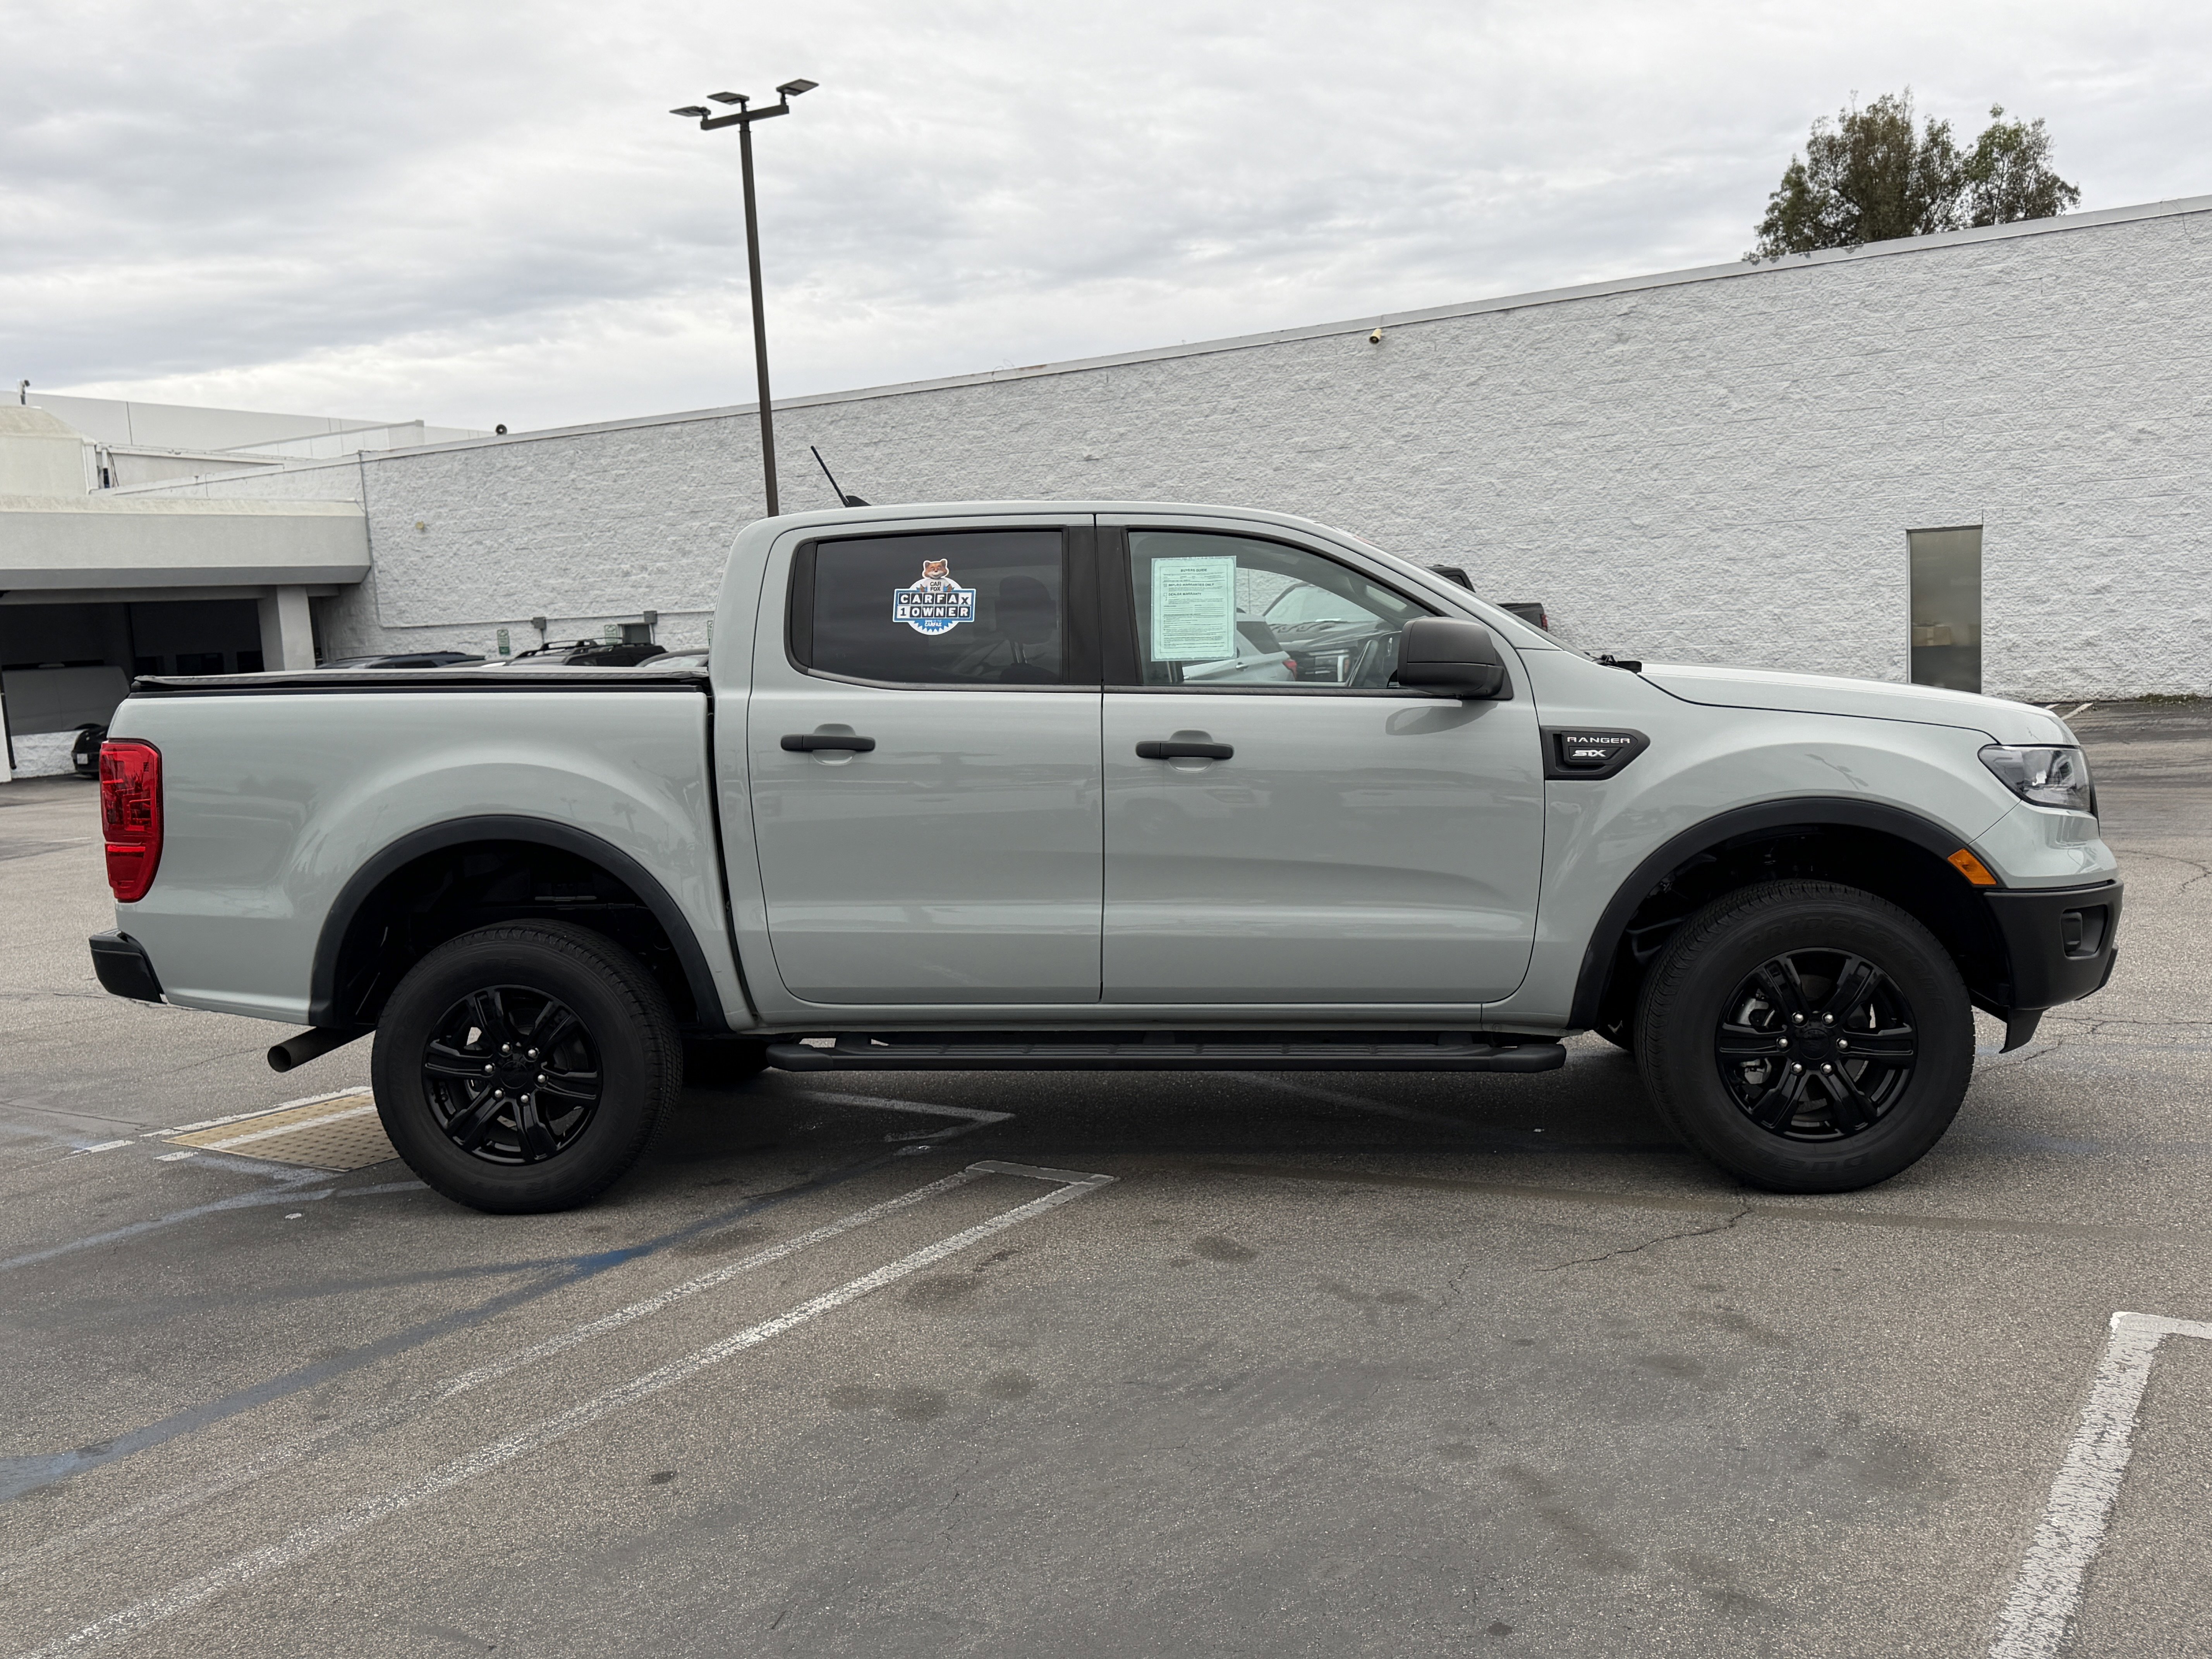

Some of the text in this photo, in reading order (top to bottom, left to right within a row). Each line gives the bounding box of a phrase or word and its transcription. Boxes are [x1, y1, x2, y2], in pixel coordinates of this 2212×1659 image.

[900, 594, 969, 605] CARFAX
[900, 608, 969, 617] 1 OWNER
